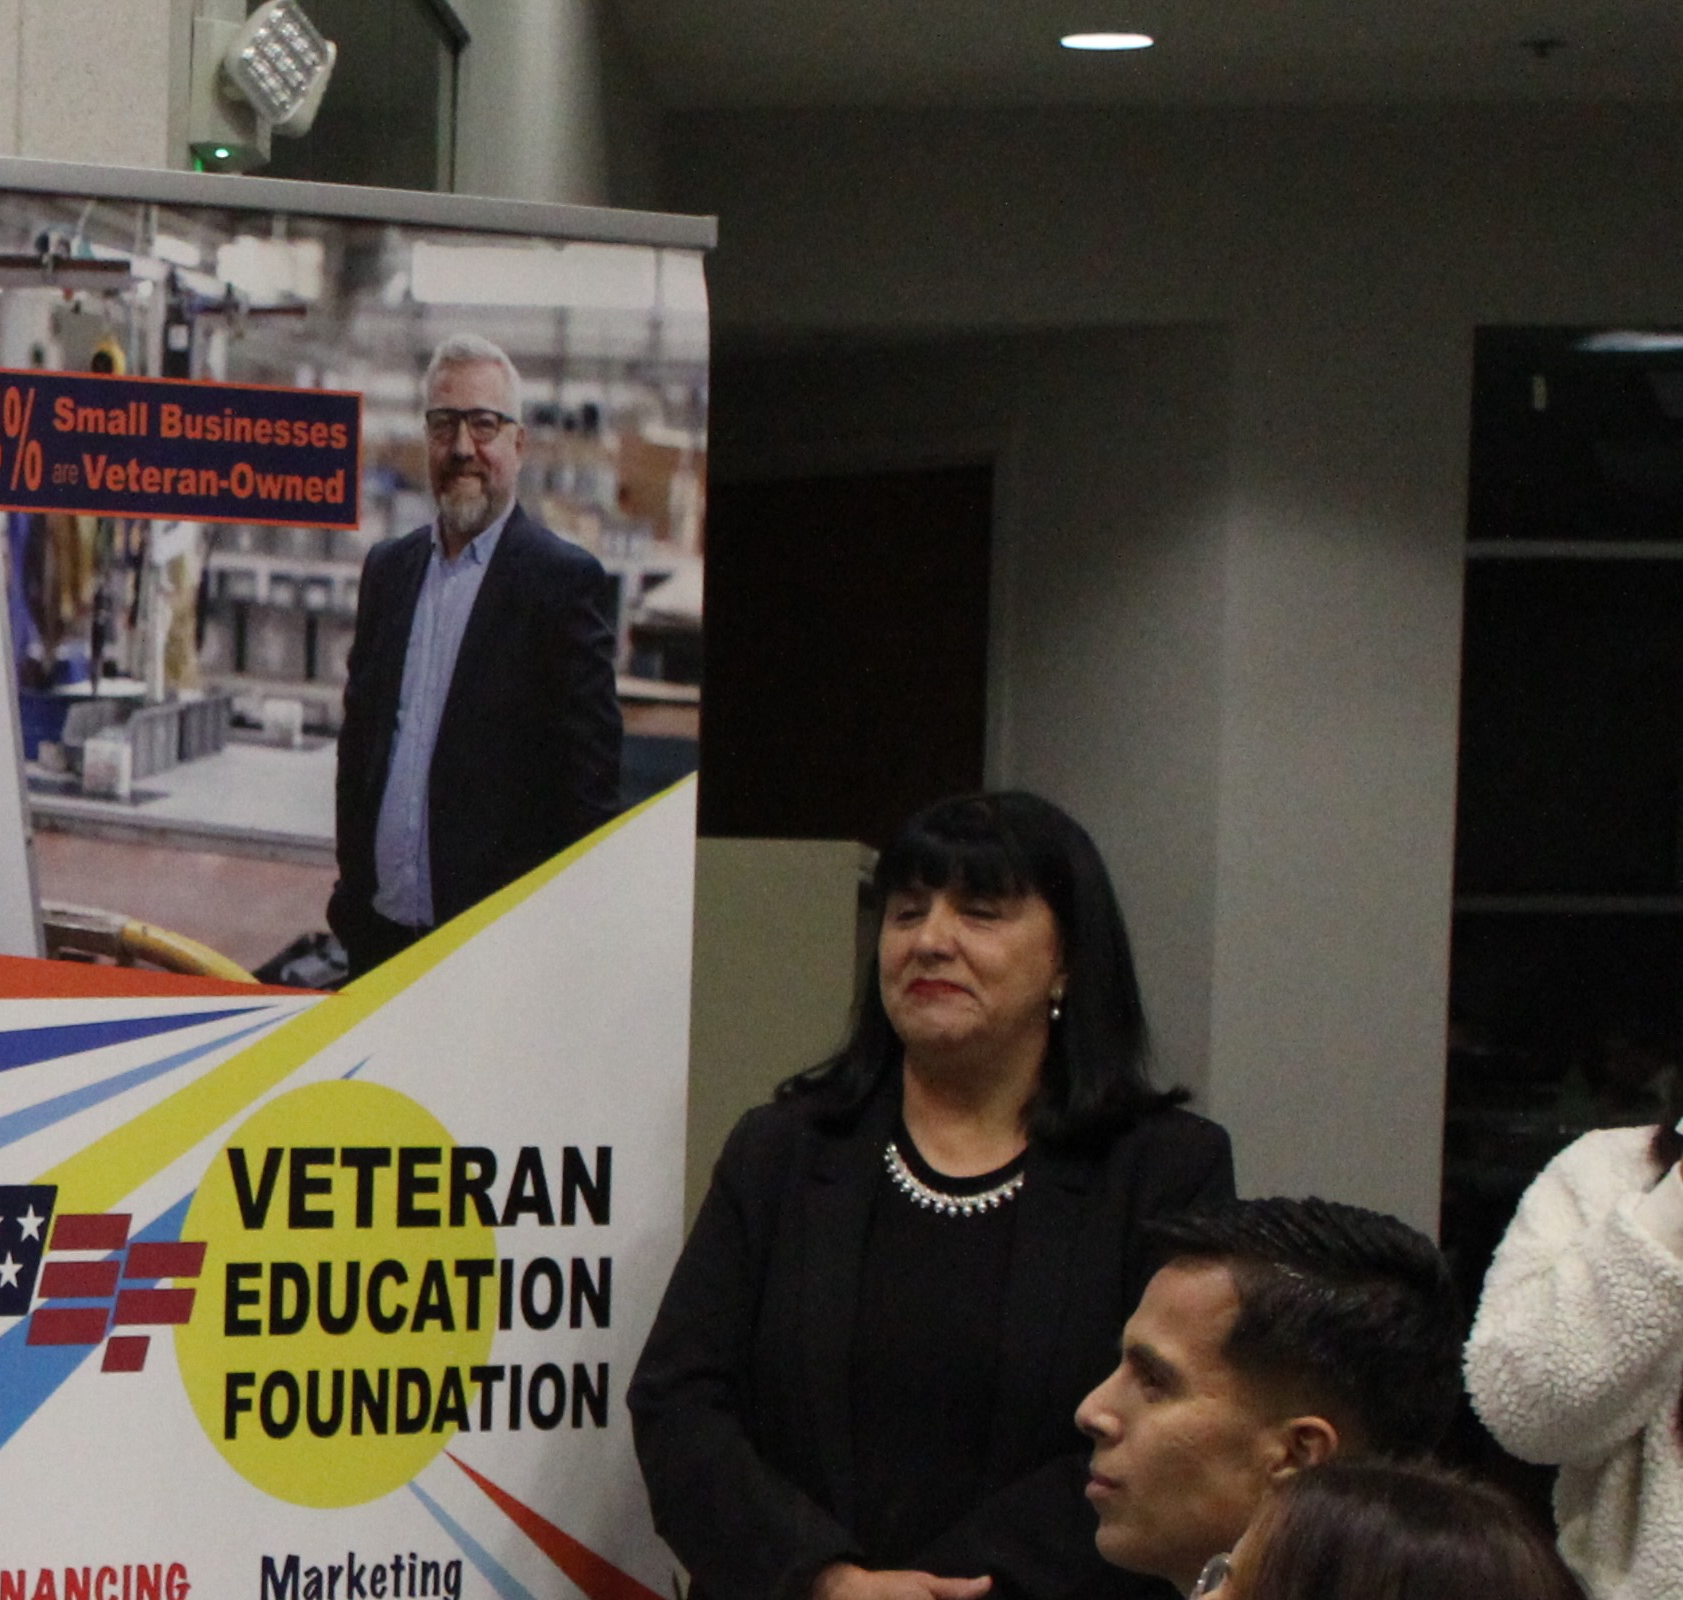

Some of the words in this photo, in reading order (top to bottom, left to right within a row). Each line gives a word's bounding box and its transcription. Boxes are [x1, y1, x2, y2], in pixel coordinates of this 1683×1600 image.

[53, 396, 148, 438] Small
[160, 404, 347, 449] Businesses
[51, 463, 79, 486] are
[82, 453, 345, 504] Veteran-Owned
[226, 1145, 612, 1229] VETERAN
[223, 1257, 612, 1337] EDUCATION
[223, 1362, 610, 1440] FOUNDATION
